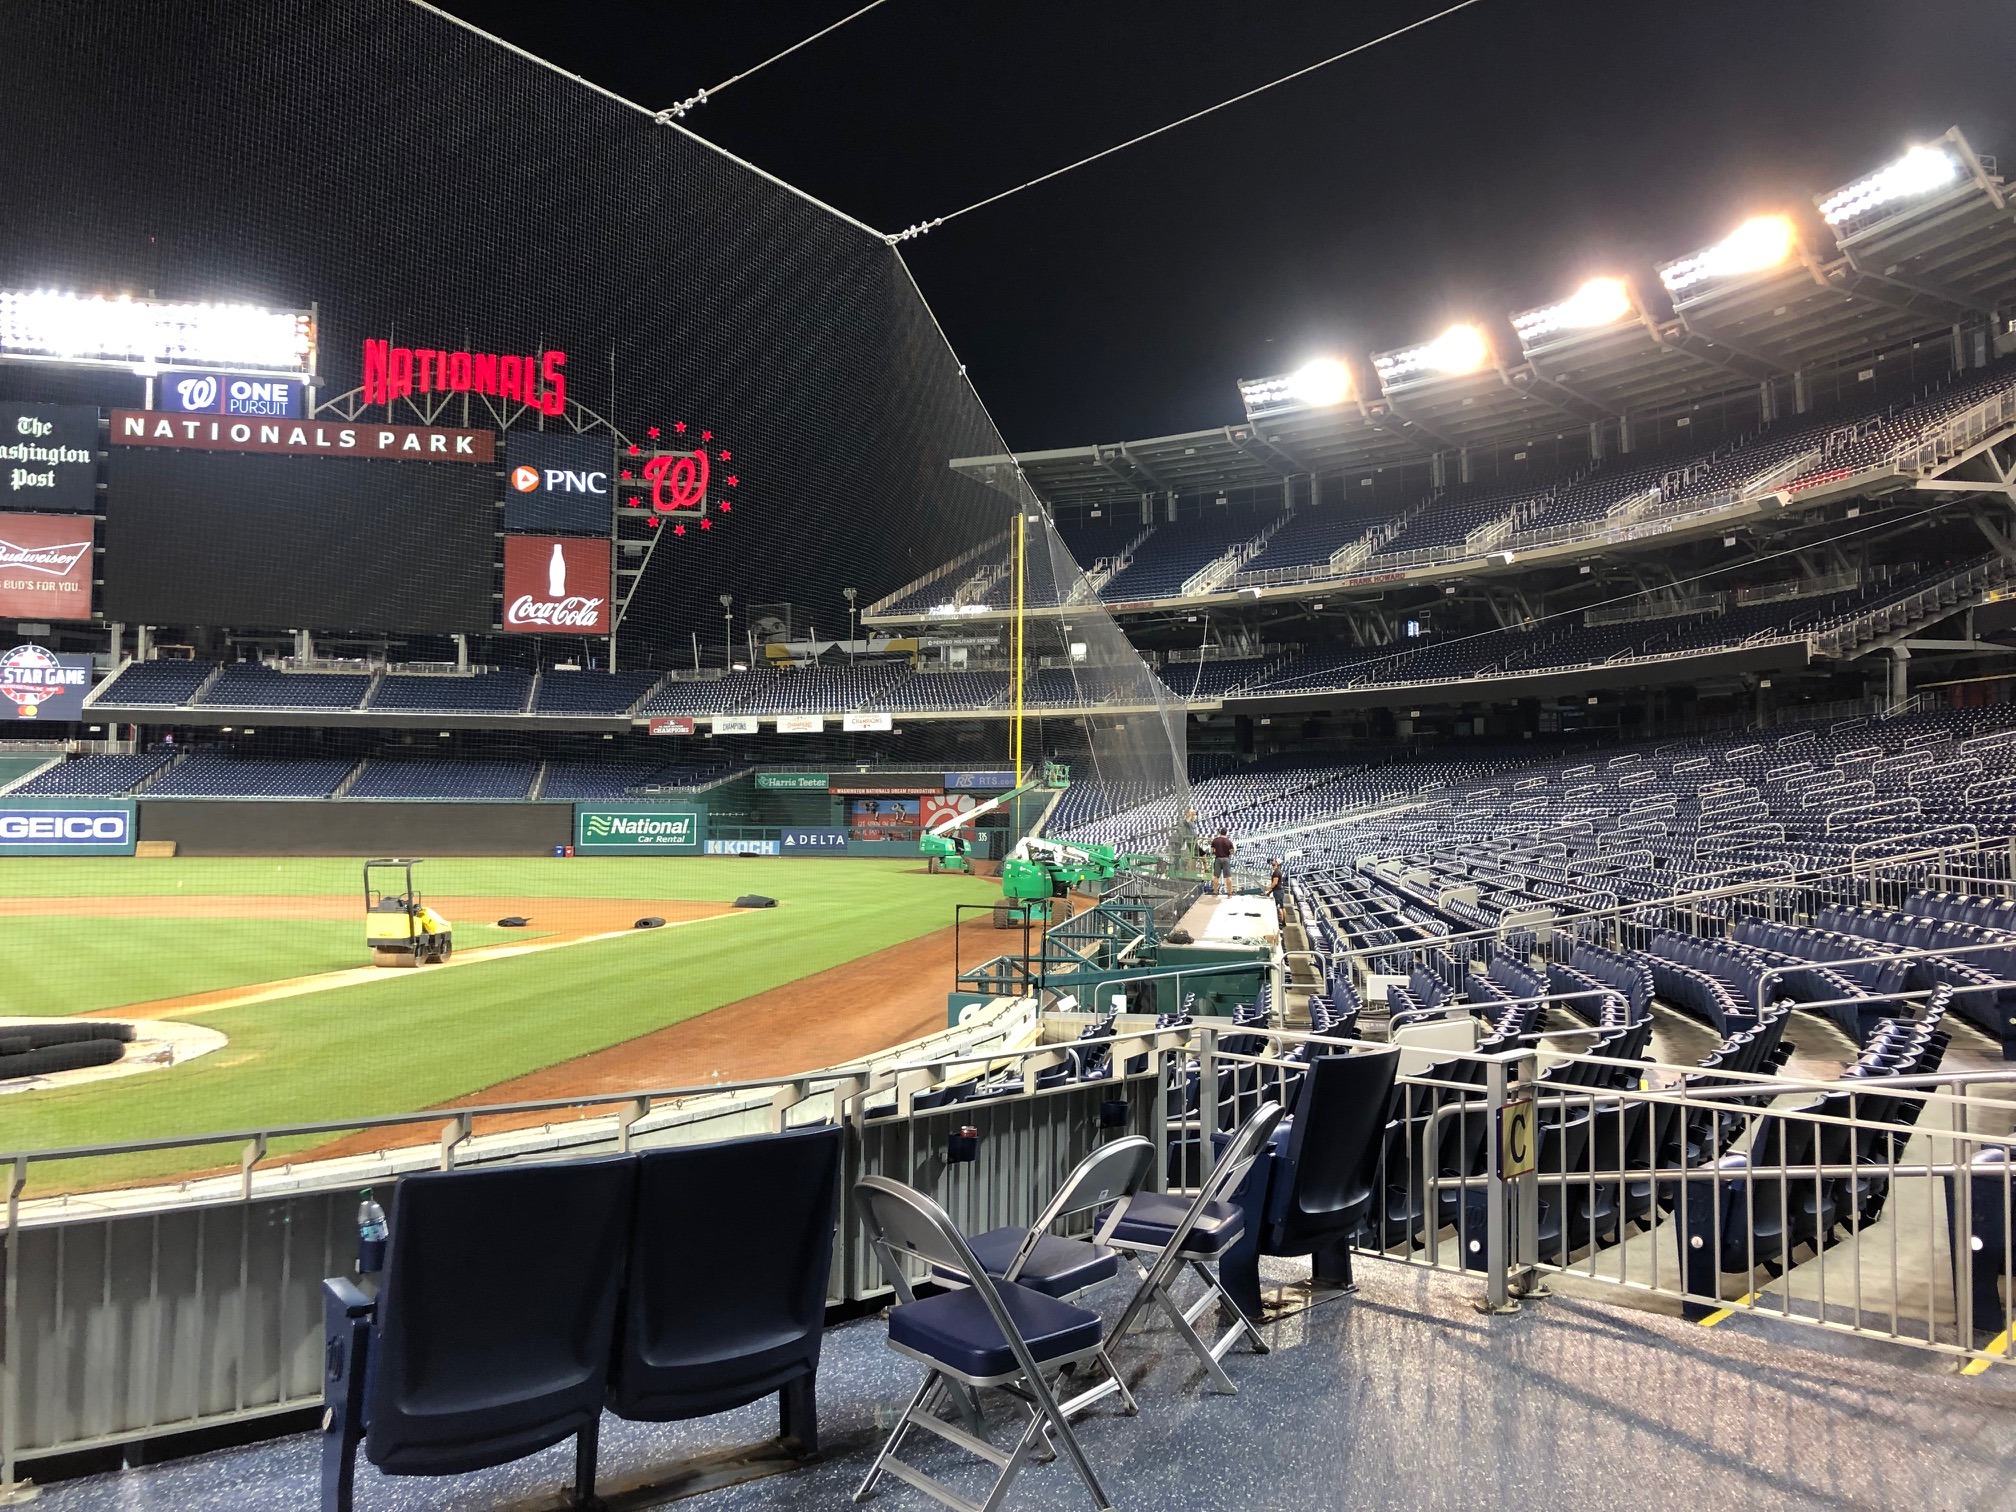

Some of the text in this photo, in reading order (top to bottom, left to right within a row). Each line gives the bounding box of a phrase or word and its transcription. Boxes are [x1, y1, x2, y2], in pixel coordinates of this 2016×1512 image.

[364, 338, 567, 416] NATIONALS
[230, 381, 289, 402] ONE
[230, 399, 289, 416] PURSUIT
[17, 416, 53, 437] The
[124, 417, 475, 454] NATIONALS PARK
[0, 442, 91, 466] ashington
[11, 468, 55, 491] Post
[544, 469, 607, 494] PNC
[4, 580, 82, 592] BUD'S FOR YOU.
[1350, 573, 1406, 586] FRANK HOWARD
[508, 595, 604, 627] Coca-Cola
[4, 667, 86, 685] STAR GAME
[723, 723, 747, 731] CHAMPIONS
[769, 777, 827, 787] Harris Teeter
[0, 816, 124, 839] GEICO
[978, 832, 988, 842] 335
[638, 835, 685, 843] Car Rental
[724, 840, 774, 855] KOCH
[799, 834, 845, 845] DELTA
[1510, 1113, 1527, 1164] C
